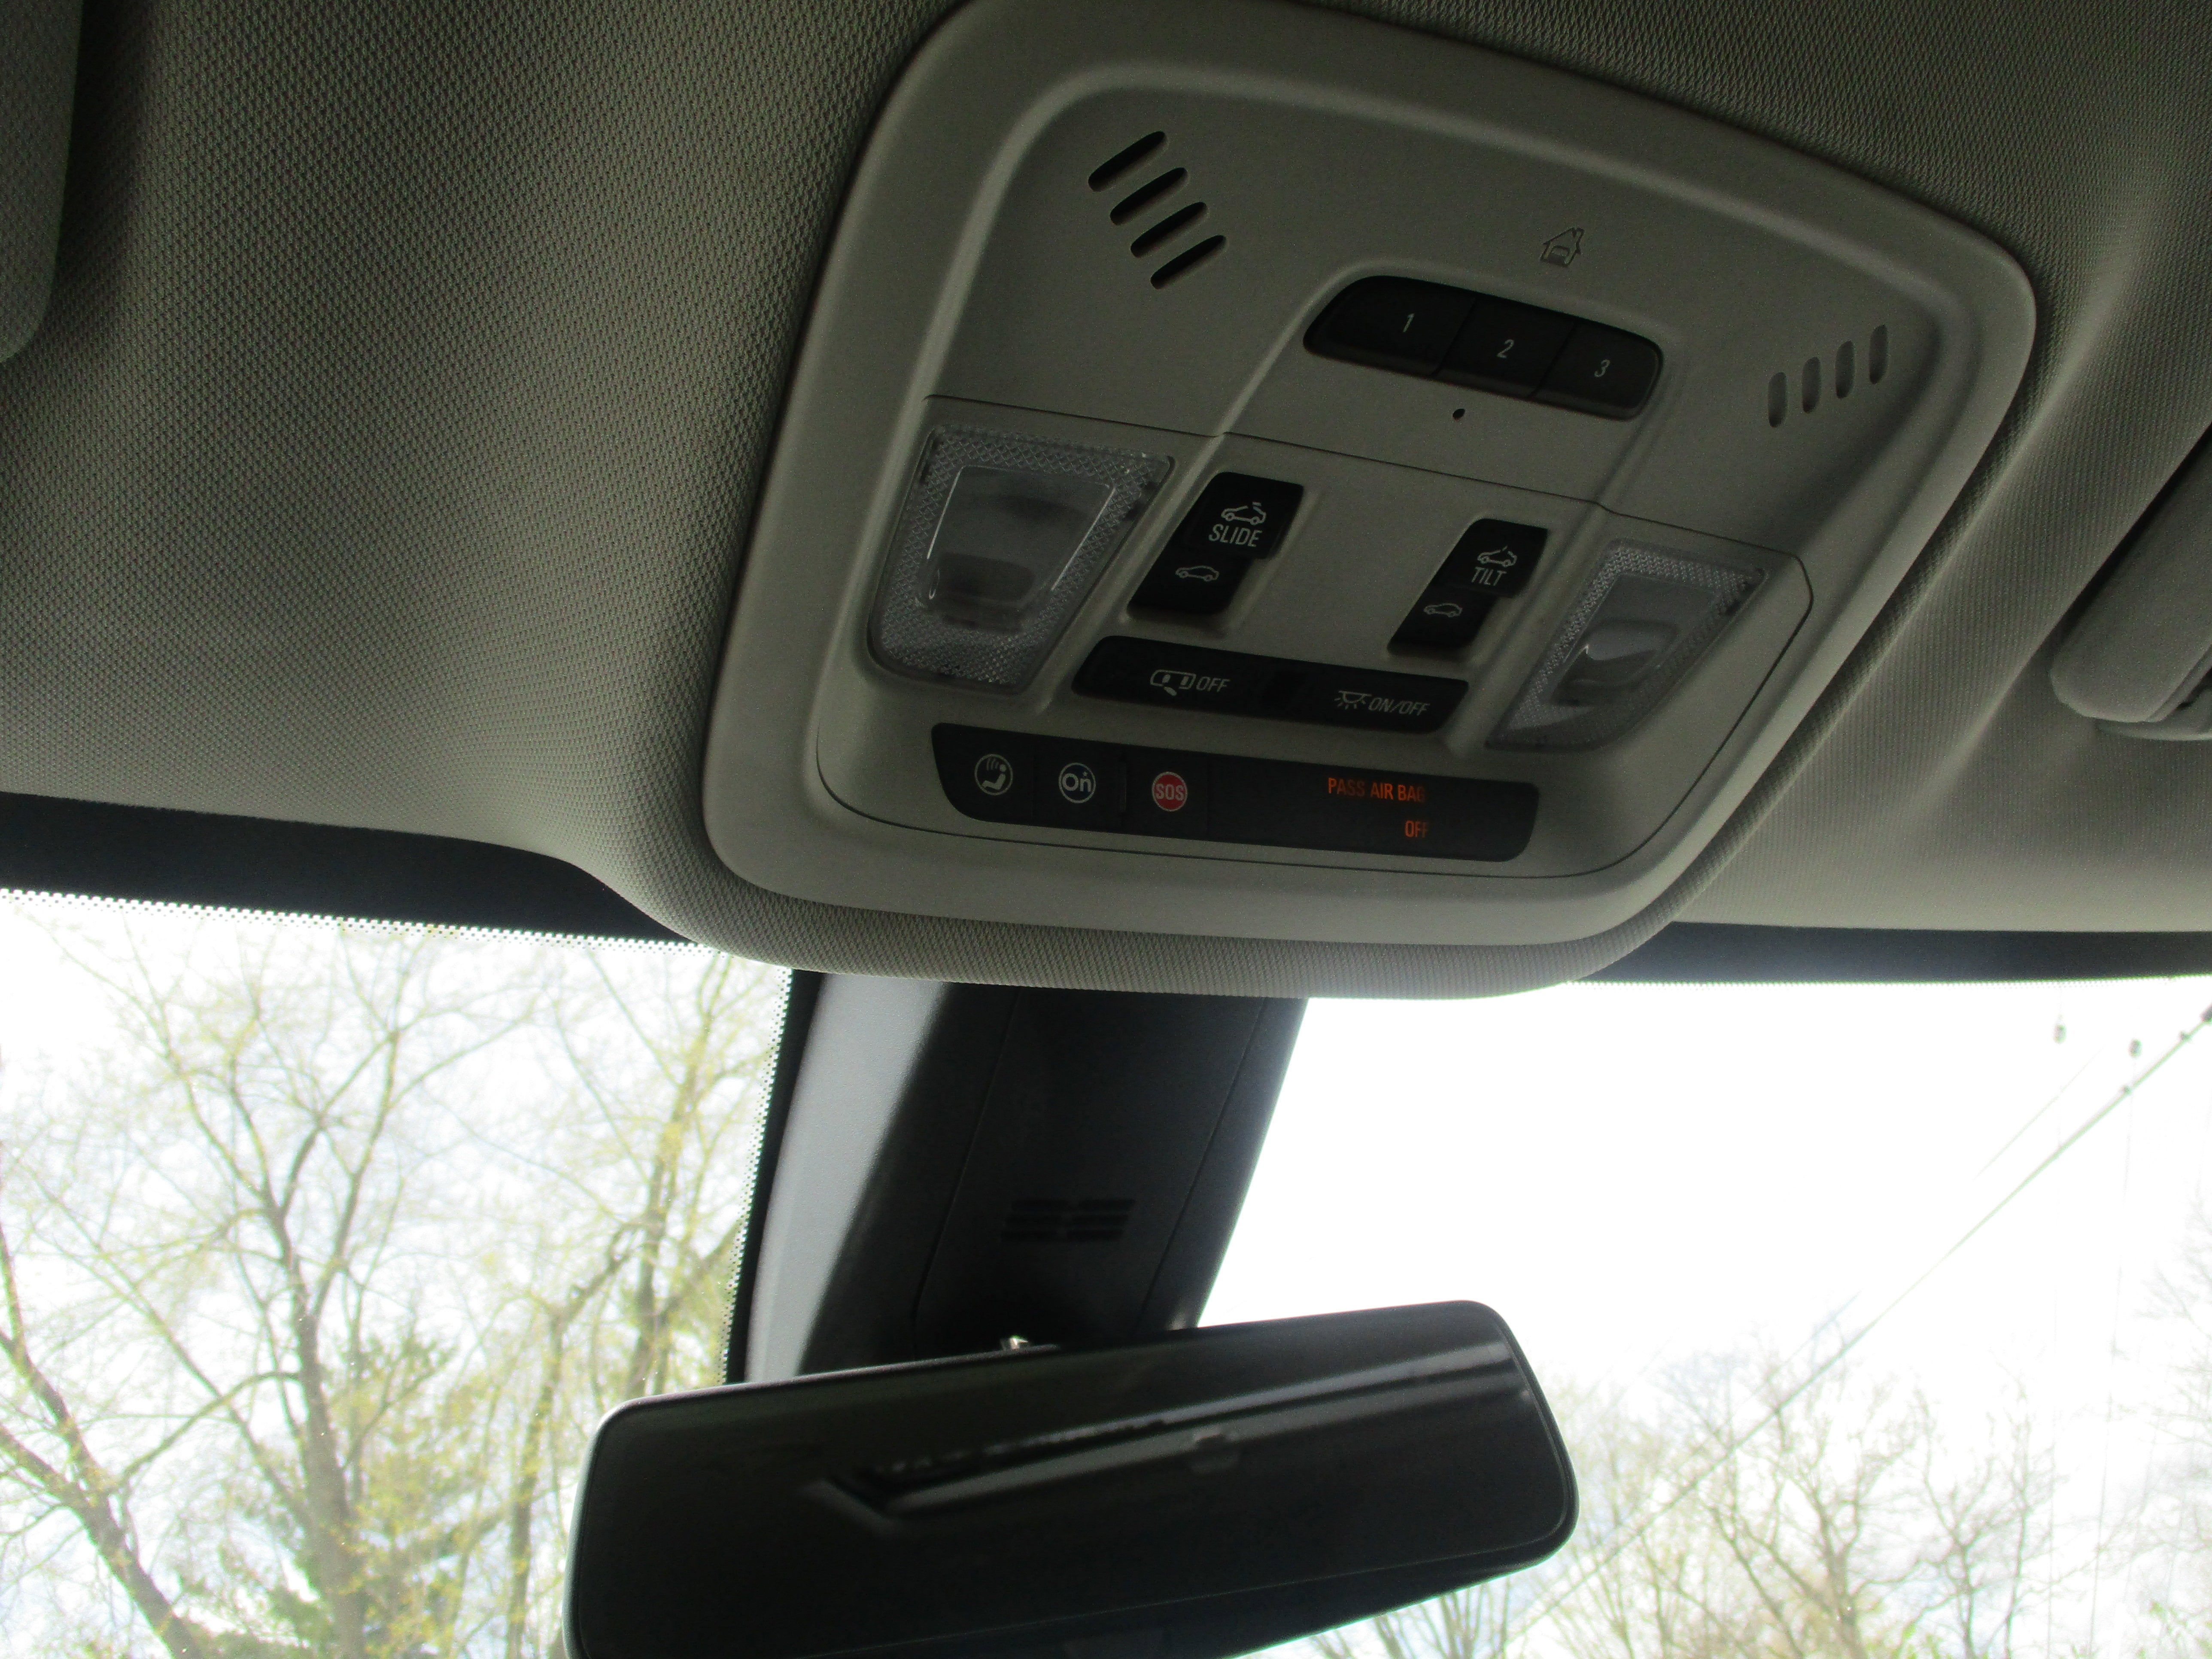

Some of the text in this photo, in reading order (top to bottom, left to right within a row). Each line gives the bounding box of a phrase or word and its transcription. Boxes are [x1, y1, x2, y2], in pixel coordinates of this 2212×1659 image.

[1402, 313, 1415, 333] 1
[1496, 339, 1515, 359] 2
[1594, 359, 1611, 379] 3
[1208, 523, 1263, 548] SLIDE
[1471, 566, 1507, 586] TILT
[1196, 677, 1231, 693] OFF
[1367, 696, 1430, 717] ON/OFF
[1155, 783, 1185, 802] SOS
[1328, 777, 1426, 803] PASS AIR BAG
[1404, 819, 1429, 838] OFF
